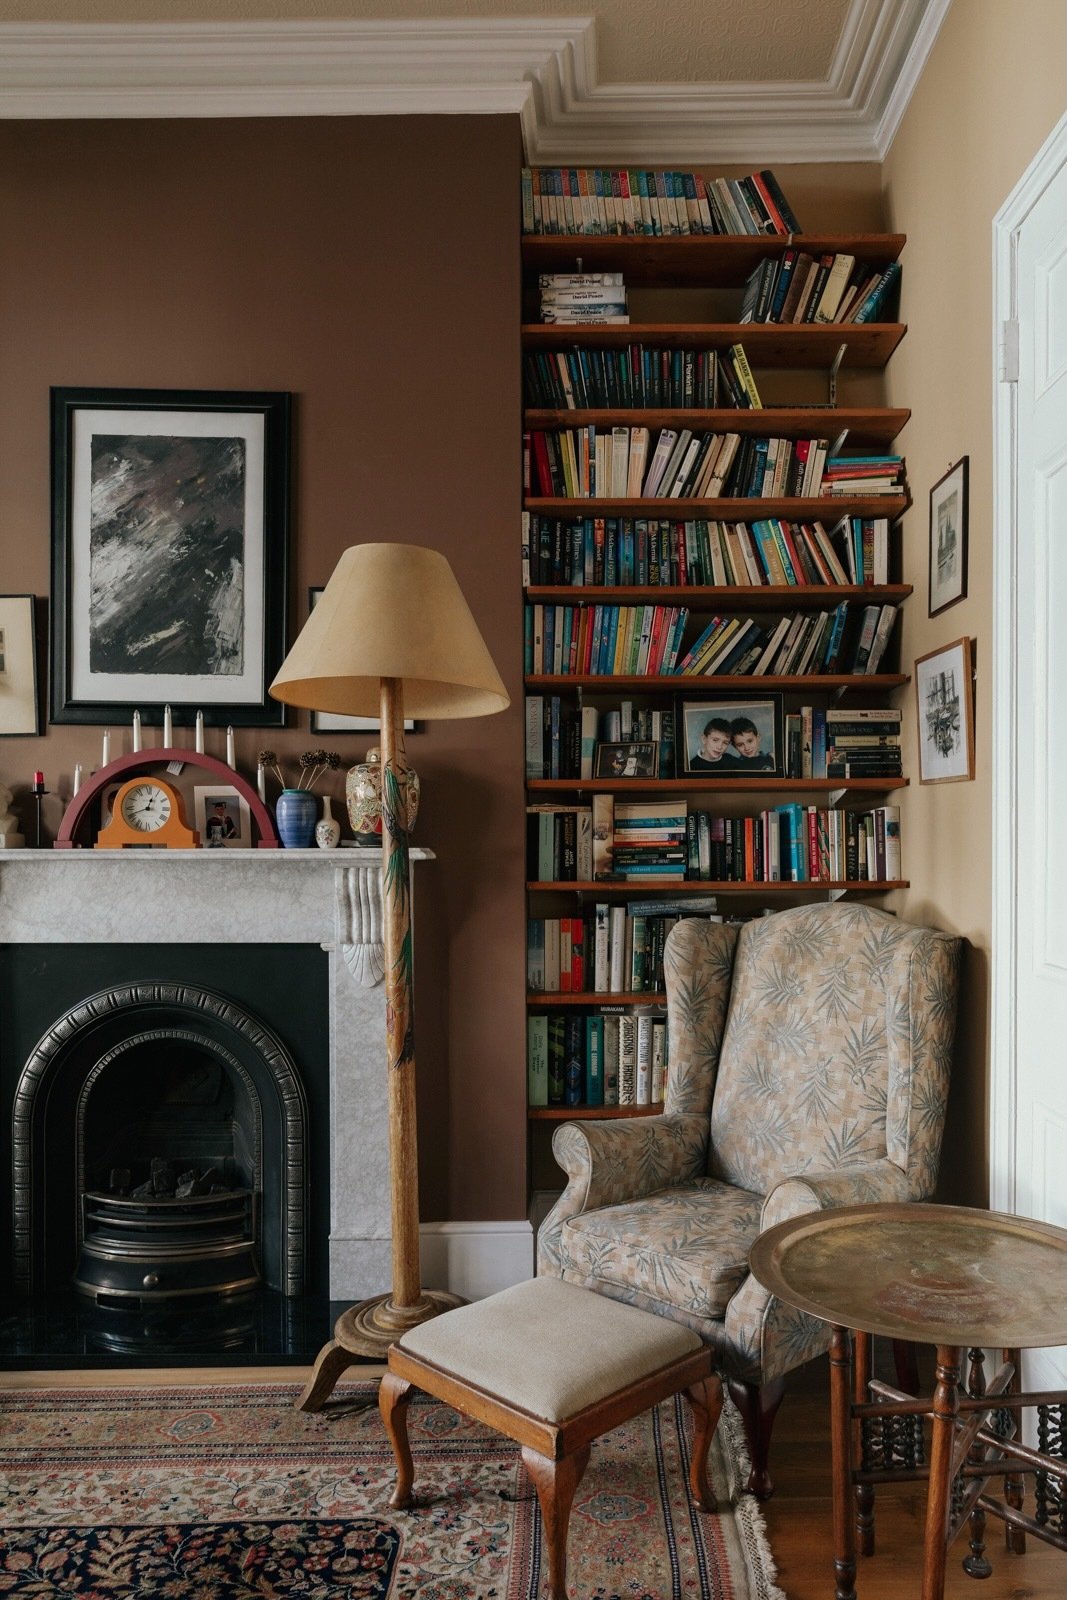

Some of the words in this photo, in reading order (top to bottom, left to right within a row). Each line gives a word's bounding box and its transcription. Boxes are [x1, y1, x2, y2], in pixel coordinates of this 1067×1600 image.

[795, 476, 803, 496] rendell
[623, 1022, 634, 1055] JONATHAN
[640, 1018, 650, 1040] MARCUS
[640, 1042, 650, 1063] CHOWN
[623, 1065, 634, 1095] FRANZEN
